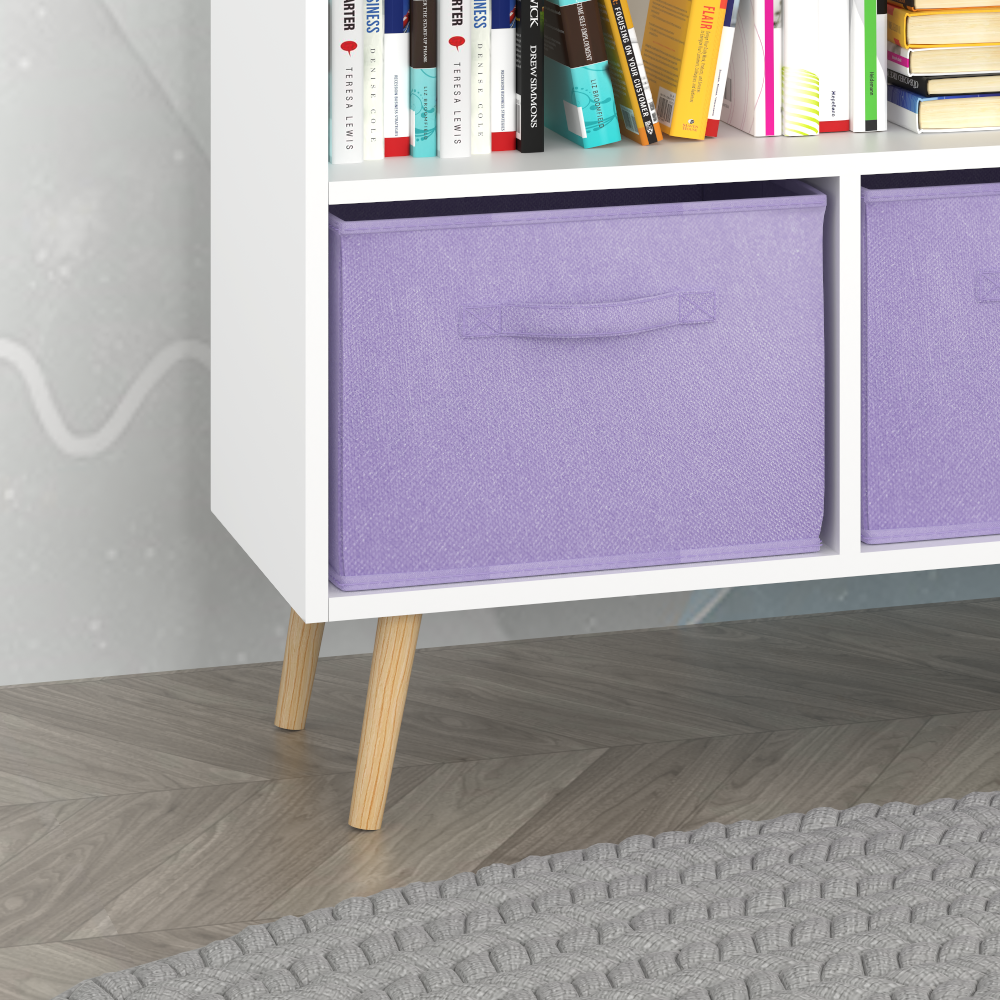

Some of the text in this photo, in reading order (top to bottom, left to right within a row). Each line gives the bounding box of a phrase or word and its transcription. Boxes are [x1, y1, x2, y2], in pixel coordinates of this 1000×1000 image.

[614, 6, 630, 44] FOCUSING
[700, 6, 716, 30] FLAIR
[624, 45, 634, 56] ON
[628, 57, 638, 77] YOUR
[346, 67, 354, 150] TERESA LEWIS
[592, 90, 604, 128] BROOMFIELD
[634, 78, 650, 118] CUSTOMER
[454, 111, 462, 144] LEWIS
